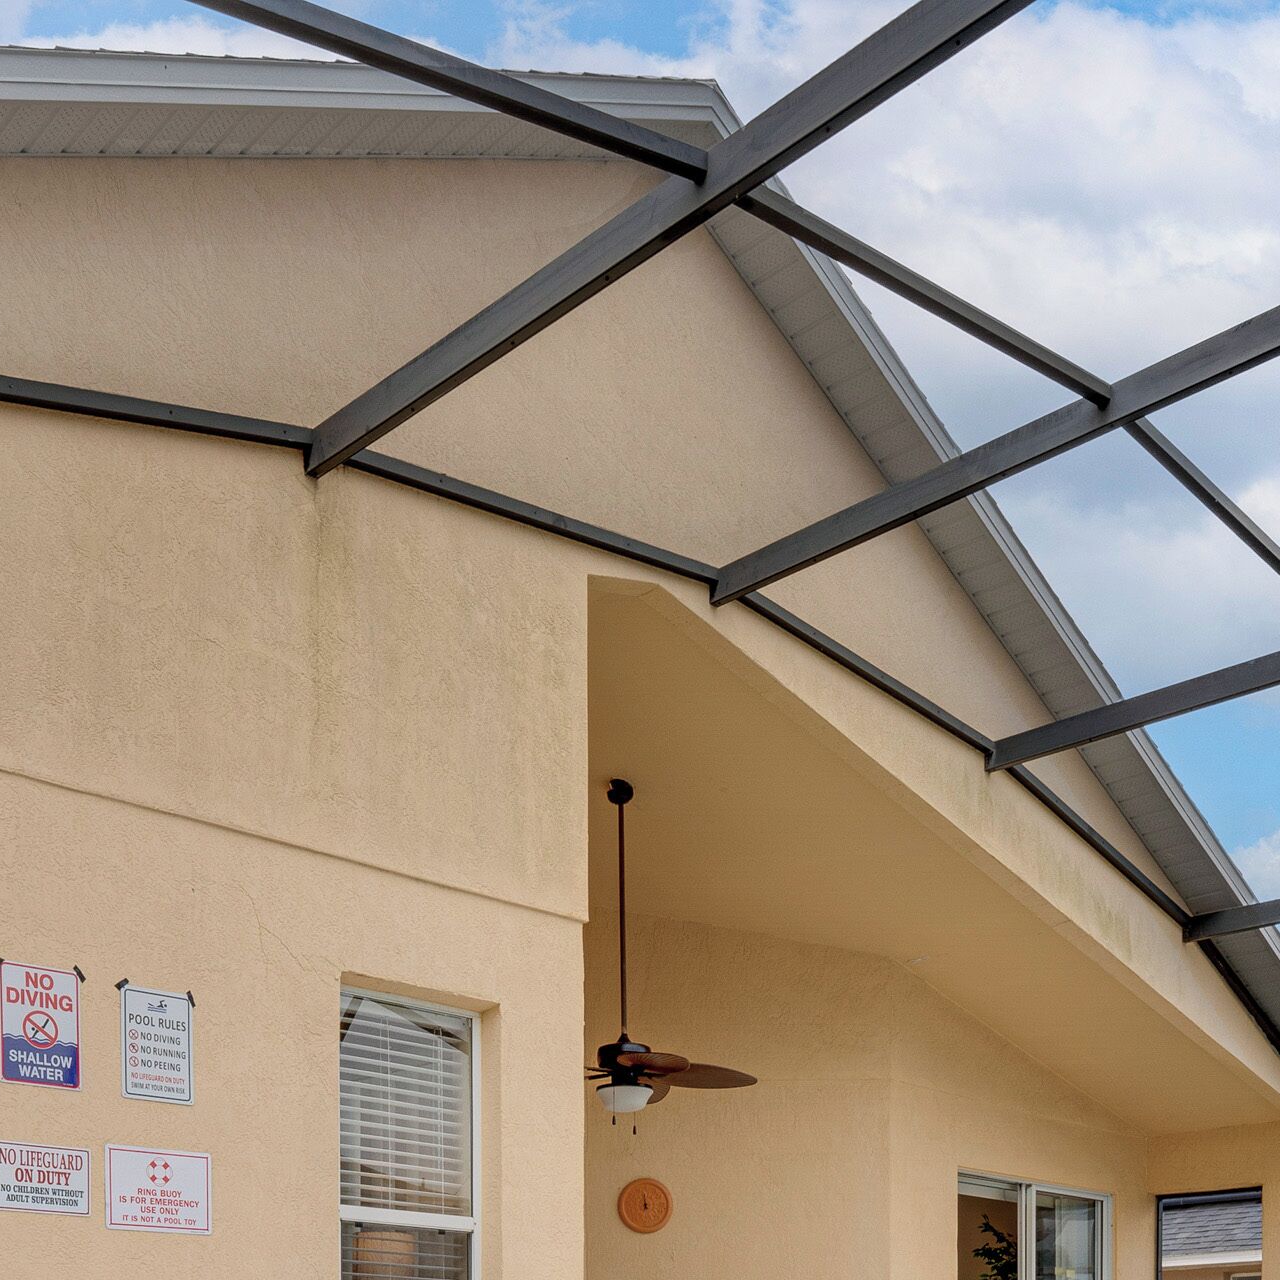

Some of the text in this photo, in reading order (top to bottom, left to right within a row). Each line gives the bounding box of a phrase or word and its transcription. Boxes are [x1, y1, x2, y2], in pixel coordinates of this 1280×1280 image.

[25, 971, 54, 990] NO
[6, 986, 73, 1012] DIVING
[129, 1013, 186, 1032] POOL RULES
[140, 1031, 180, 1046] NO DIVING
[9, 1049, 72, 1068] SHALLOW
[140, 1045, 186, 1060] NO RUNNING
[18, 1064, 63, 1081] WATER
[141, 1059, 181, 1072] NO PEEING
[140, 1073, 164, 1083] LIFEGUARD
[173, 1077, 185, 1085] DUTY
[131, 1081, 144, 1089] SWIM
[151, 1084, 163, 1092] YOUR
[164, 1085, 175, 1093] OWN
[176, 1087, 185, 1095] RISK
[0, 1148, 83, 1171] NO LIFEGUARD
[15, 1168, 71, 1186] ON DUTY
[0, 1184, 84, 1198] NO CHILDREN WITHOUT
[137, 1188, 182, 1198] RING BUOY
[6, 1194, 79, 1206] ADULT SUPERVISION
[119, 1195, 200, 1208] IS FOR EMERGENCY
[140, 1206, 180, 1215] USE ONLY
[164, 1217, 182, 1225] POOL
